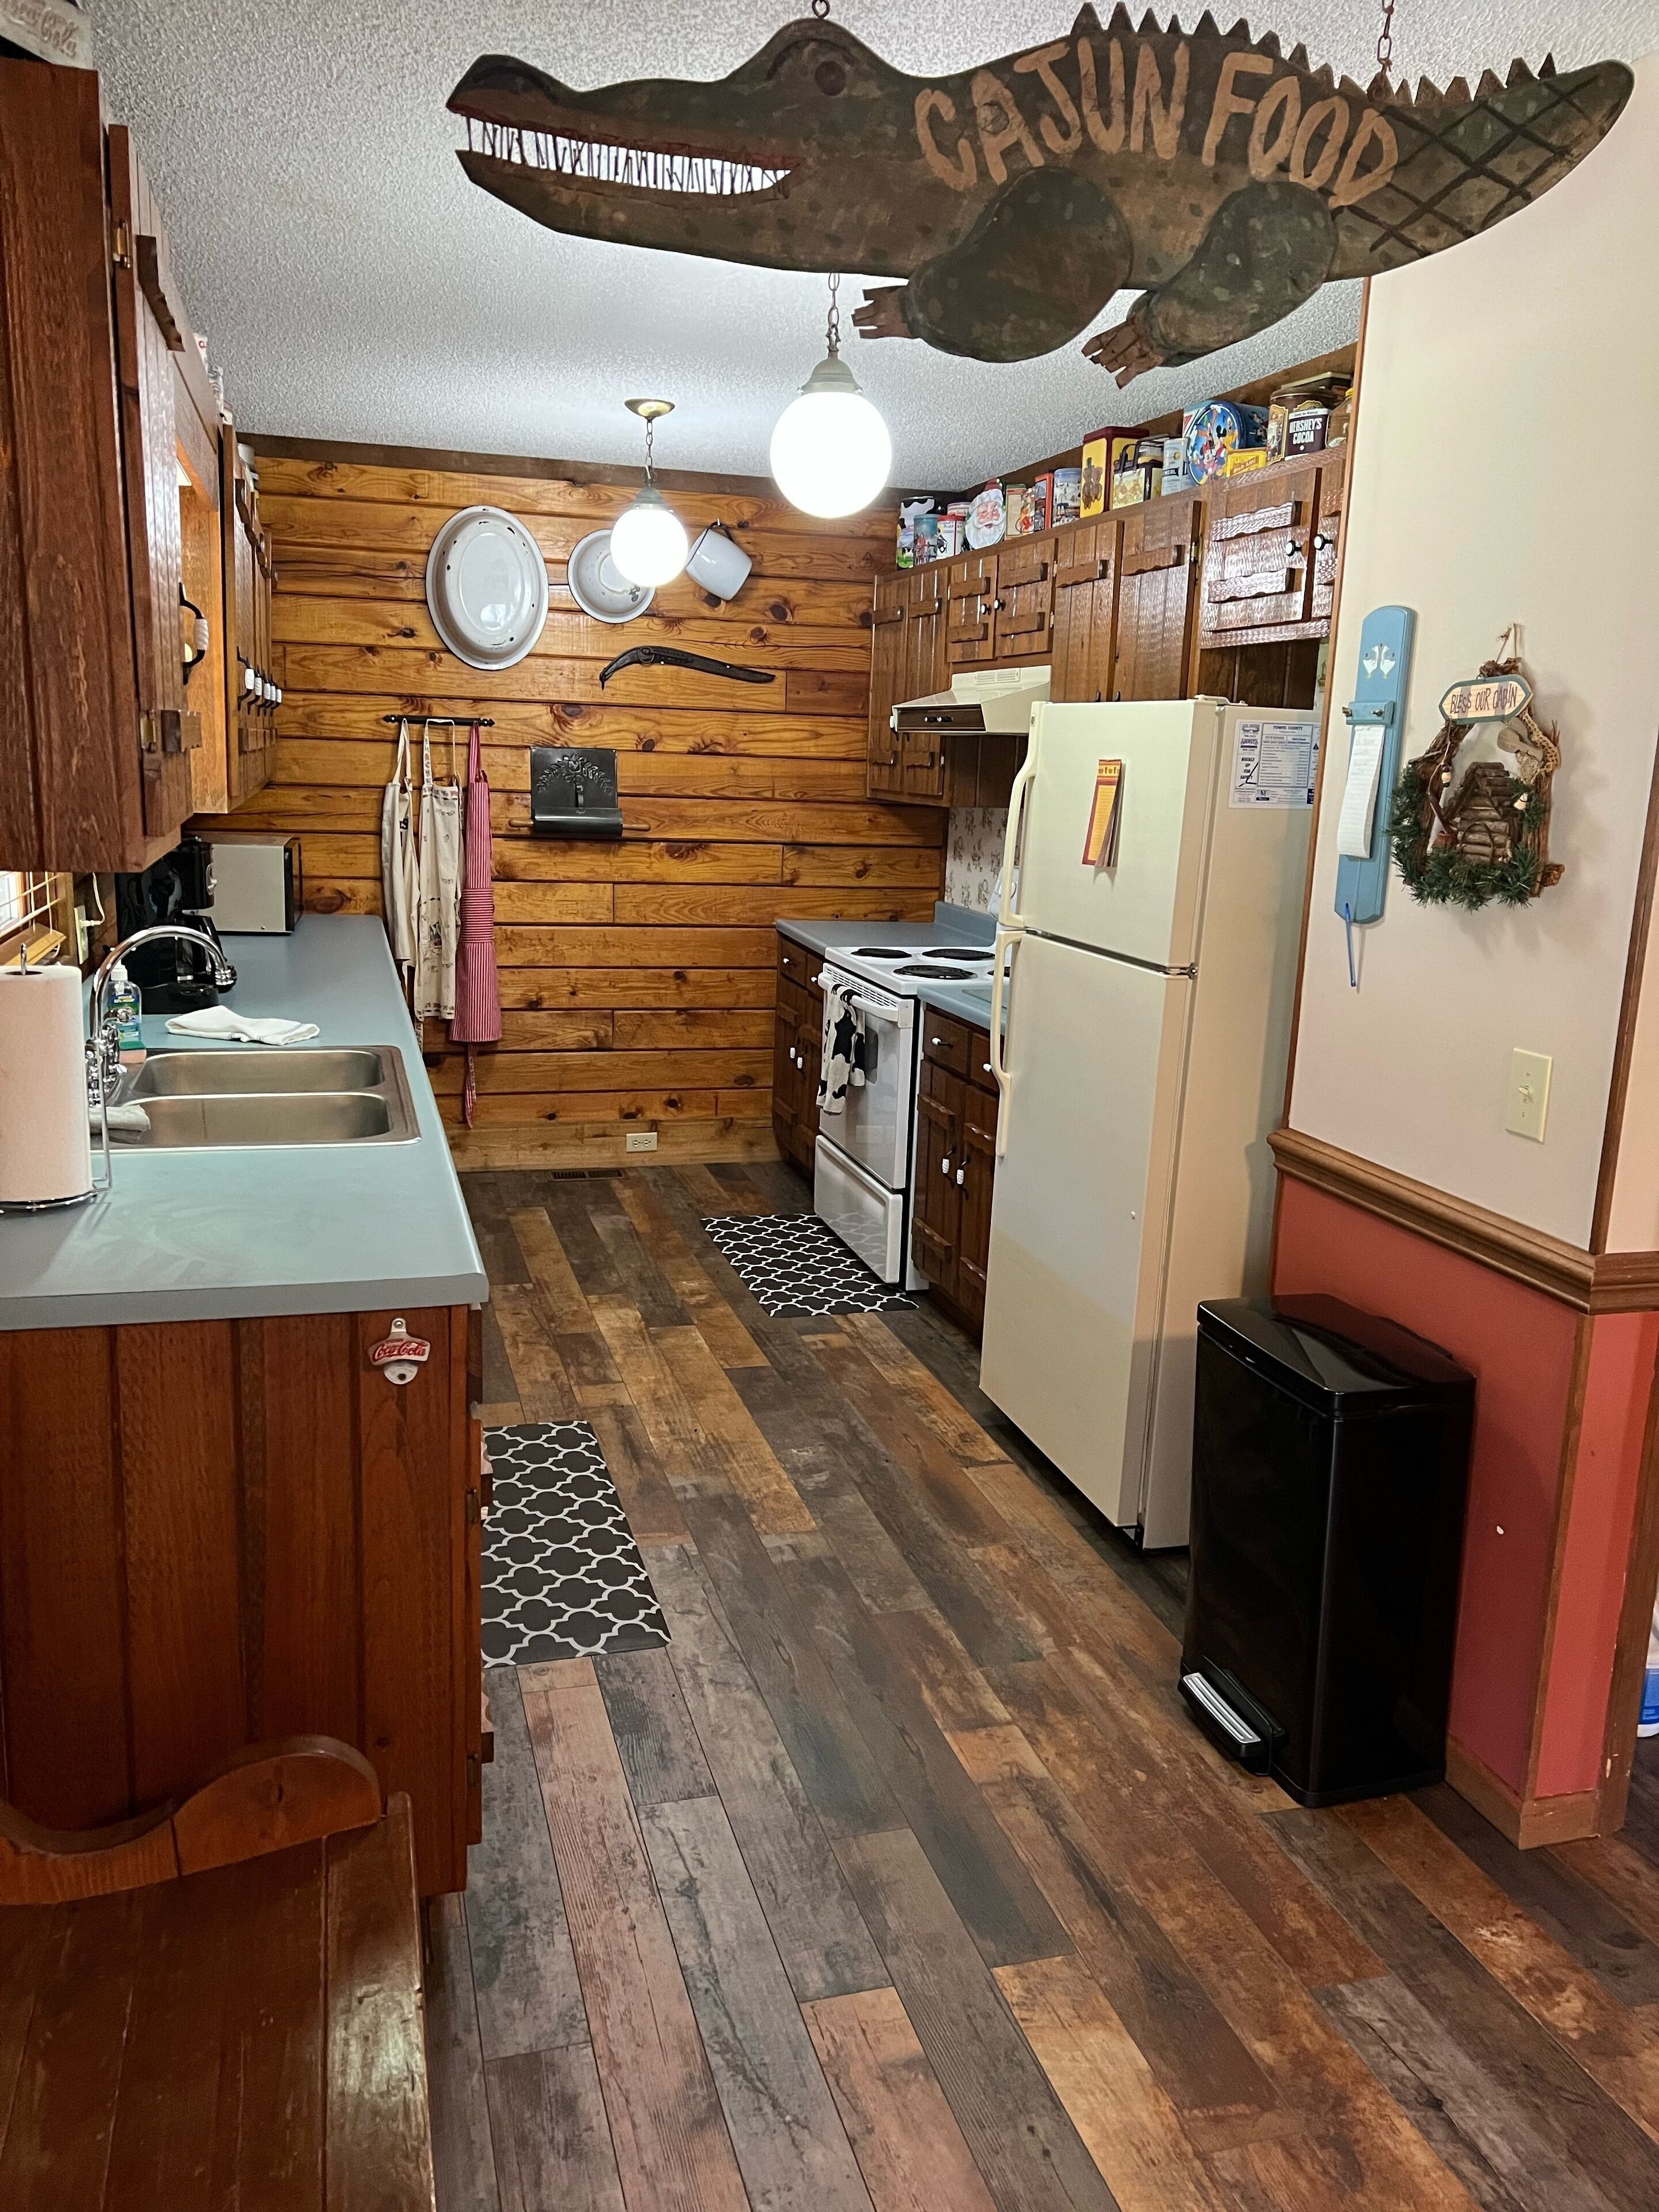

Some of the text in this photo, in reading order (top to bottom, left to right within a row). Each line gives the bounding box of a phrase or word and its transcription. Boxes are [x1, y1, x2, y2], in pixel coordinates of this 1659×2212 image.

[916, 37, 1399, 207] CAJUN FOOD
[1289, 418, 1323, 434] HERSHEY'S
[1293, 430, 1315, 445] COCOA
[1450, 683, 1518, 714] BLESS OUR CABIN
